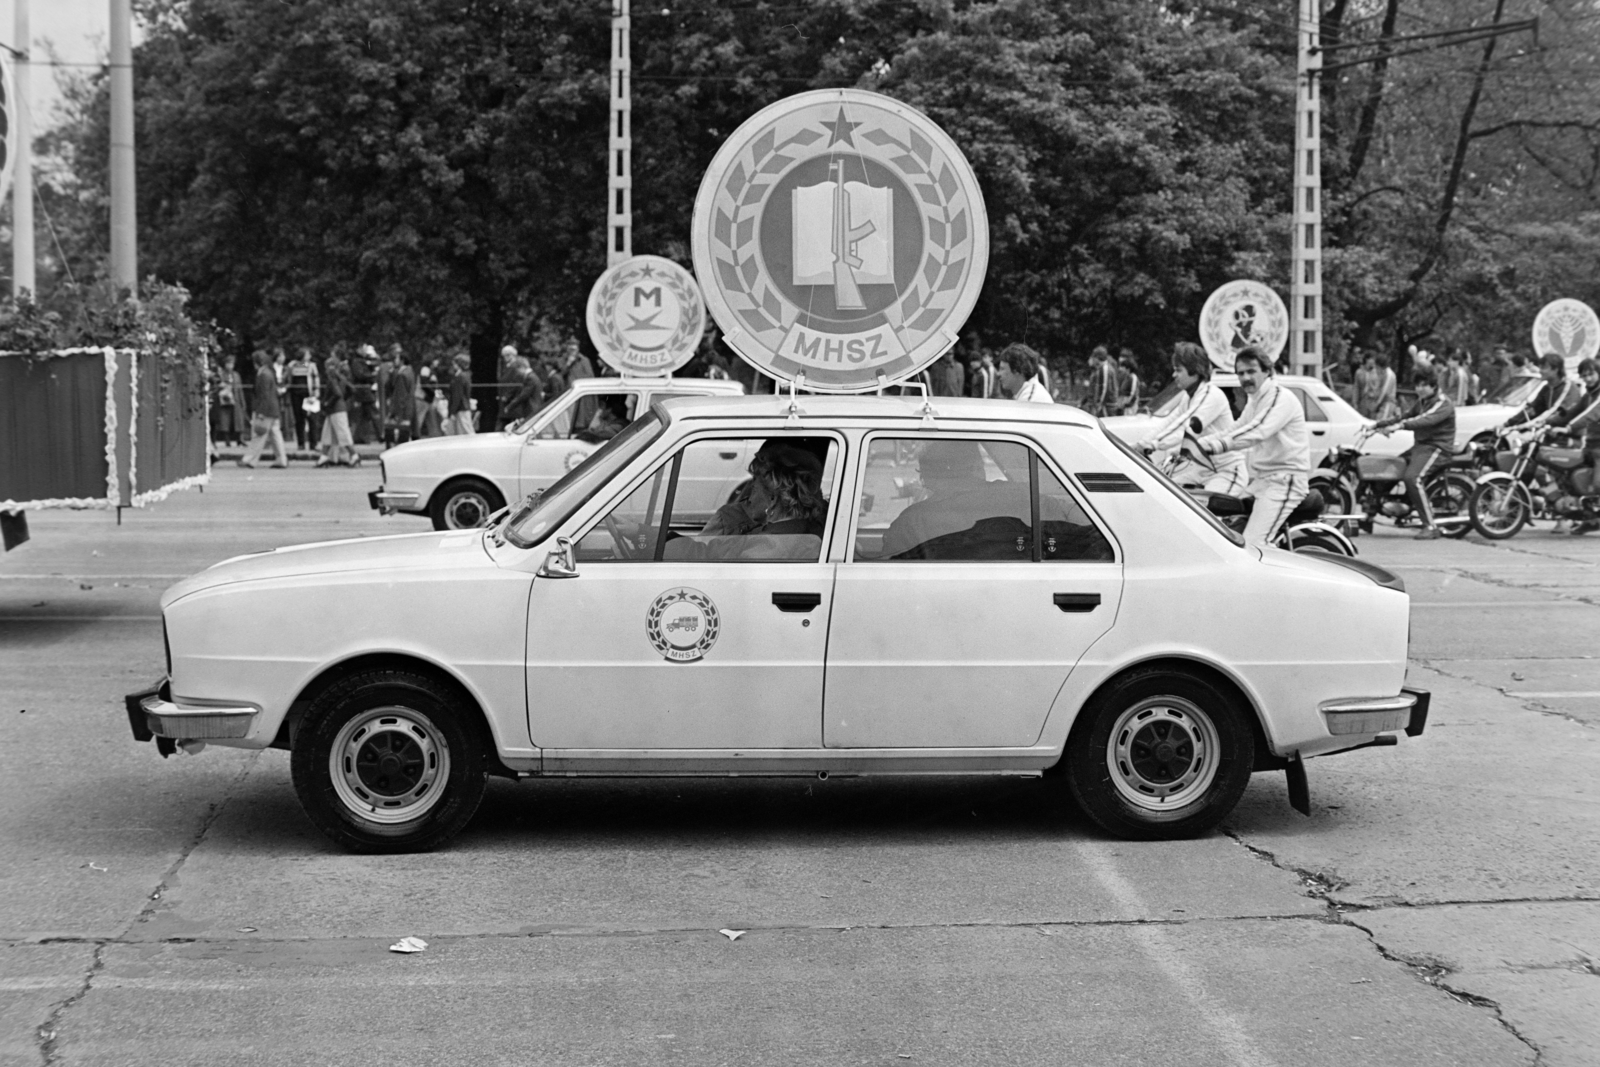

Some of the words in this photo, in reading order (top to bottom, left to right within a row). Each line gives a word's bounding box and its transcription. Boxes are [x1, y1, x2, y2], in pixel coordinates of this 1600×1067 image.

[634, 287, 661, 307] M
[793, 331, 888, 363] MHSZ
[627, 351, 667, 364] MHSZ
[670, 650, 697, 659] MHSZ
